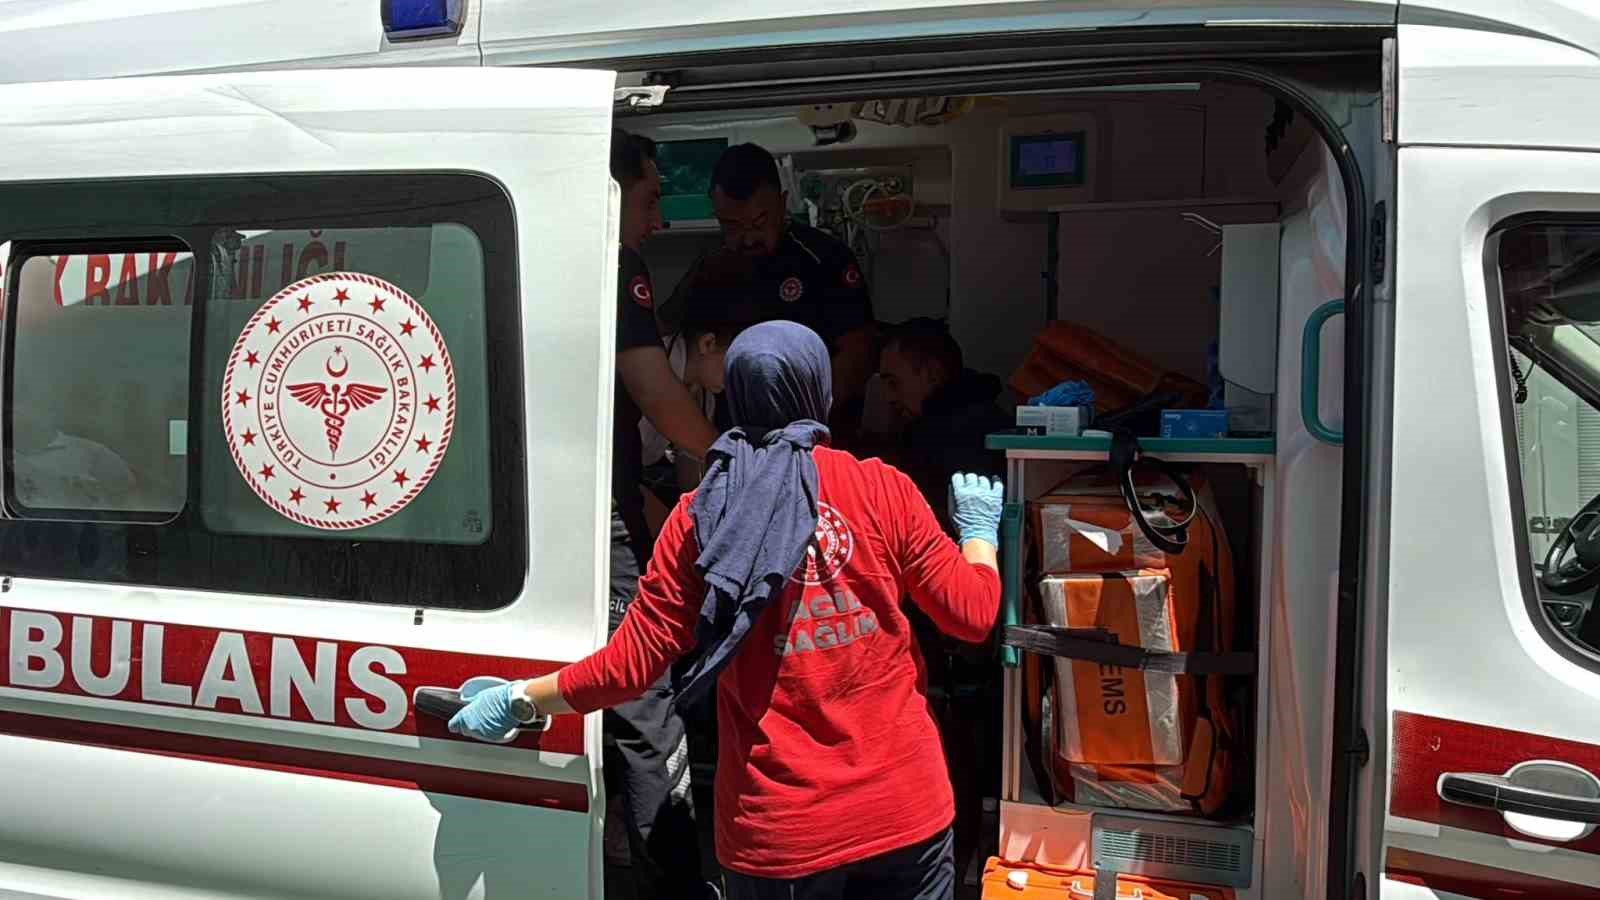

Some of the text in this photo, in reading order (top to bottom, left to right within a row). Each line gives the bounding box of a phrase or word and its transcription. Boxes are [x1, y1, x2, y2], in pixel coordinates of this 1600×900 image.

[264, 317, 353, 395] CUMHURİYETİ
[356, 324, 405, 373] SAĞLIK
[368, 376, 411, 470] BAKANLIĞI
[773, 609, 879, 657] SAĞLIK
[9, 610, 409, 730] BULANS
[1099, 663, 1126, 715] EMS
